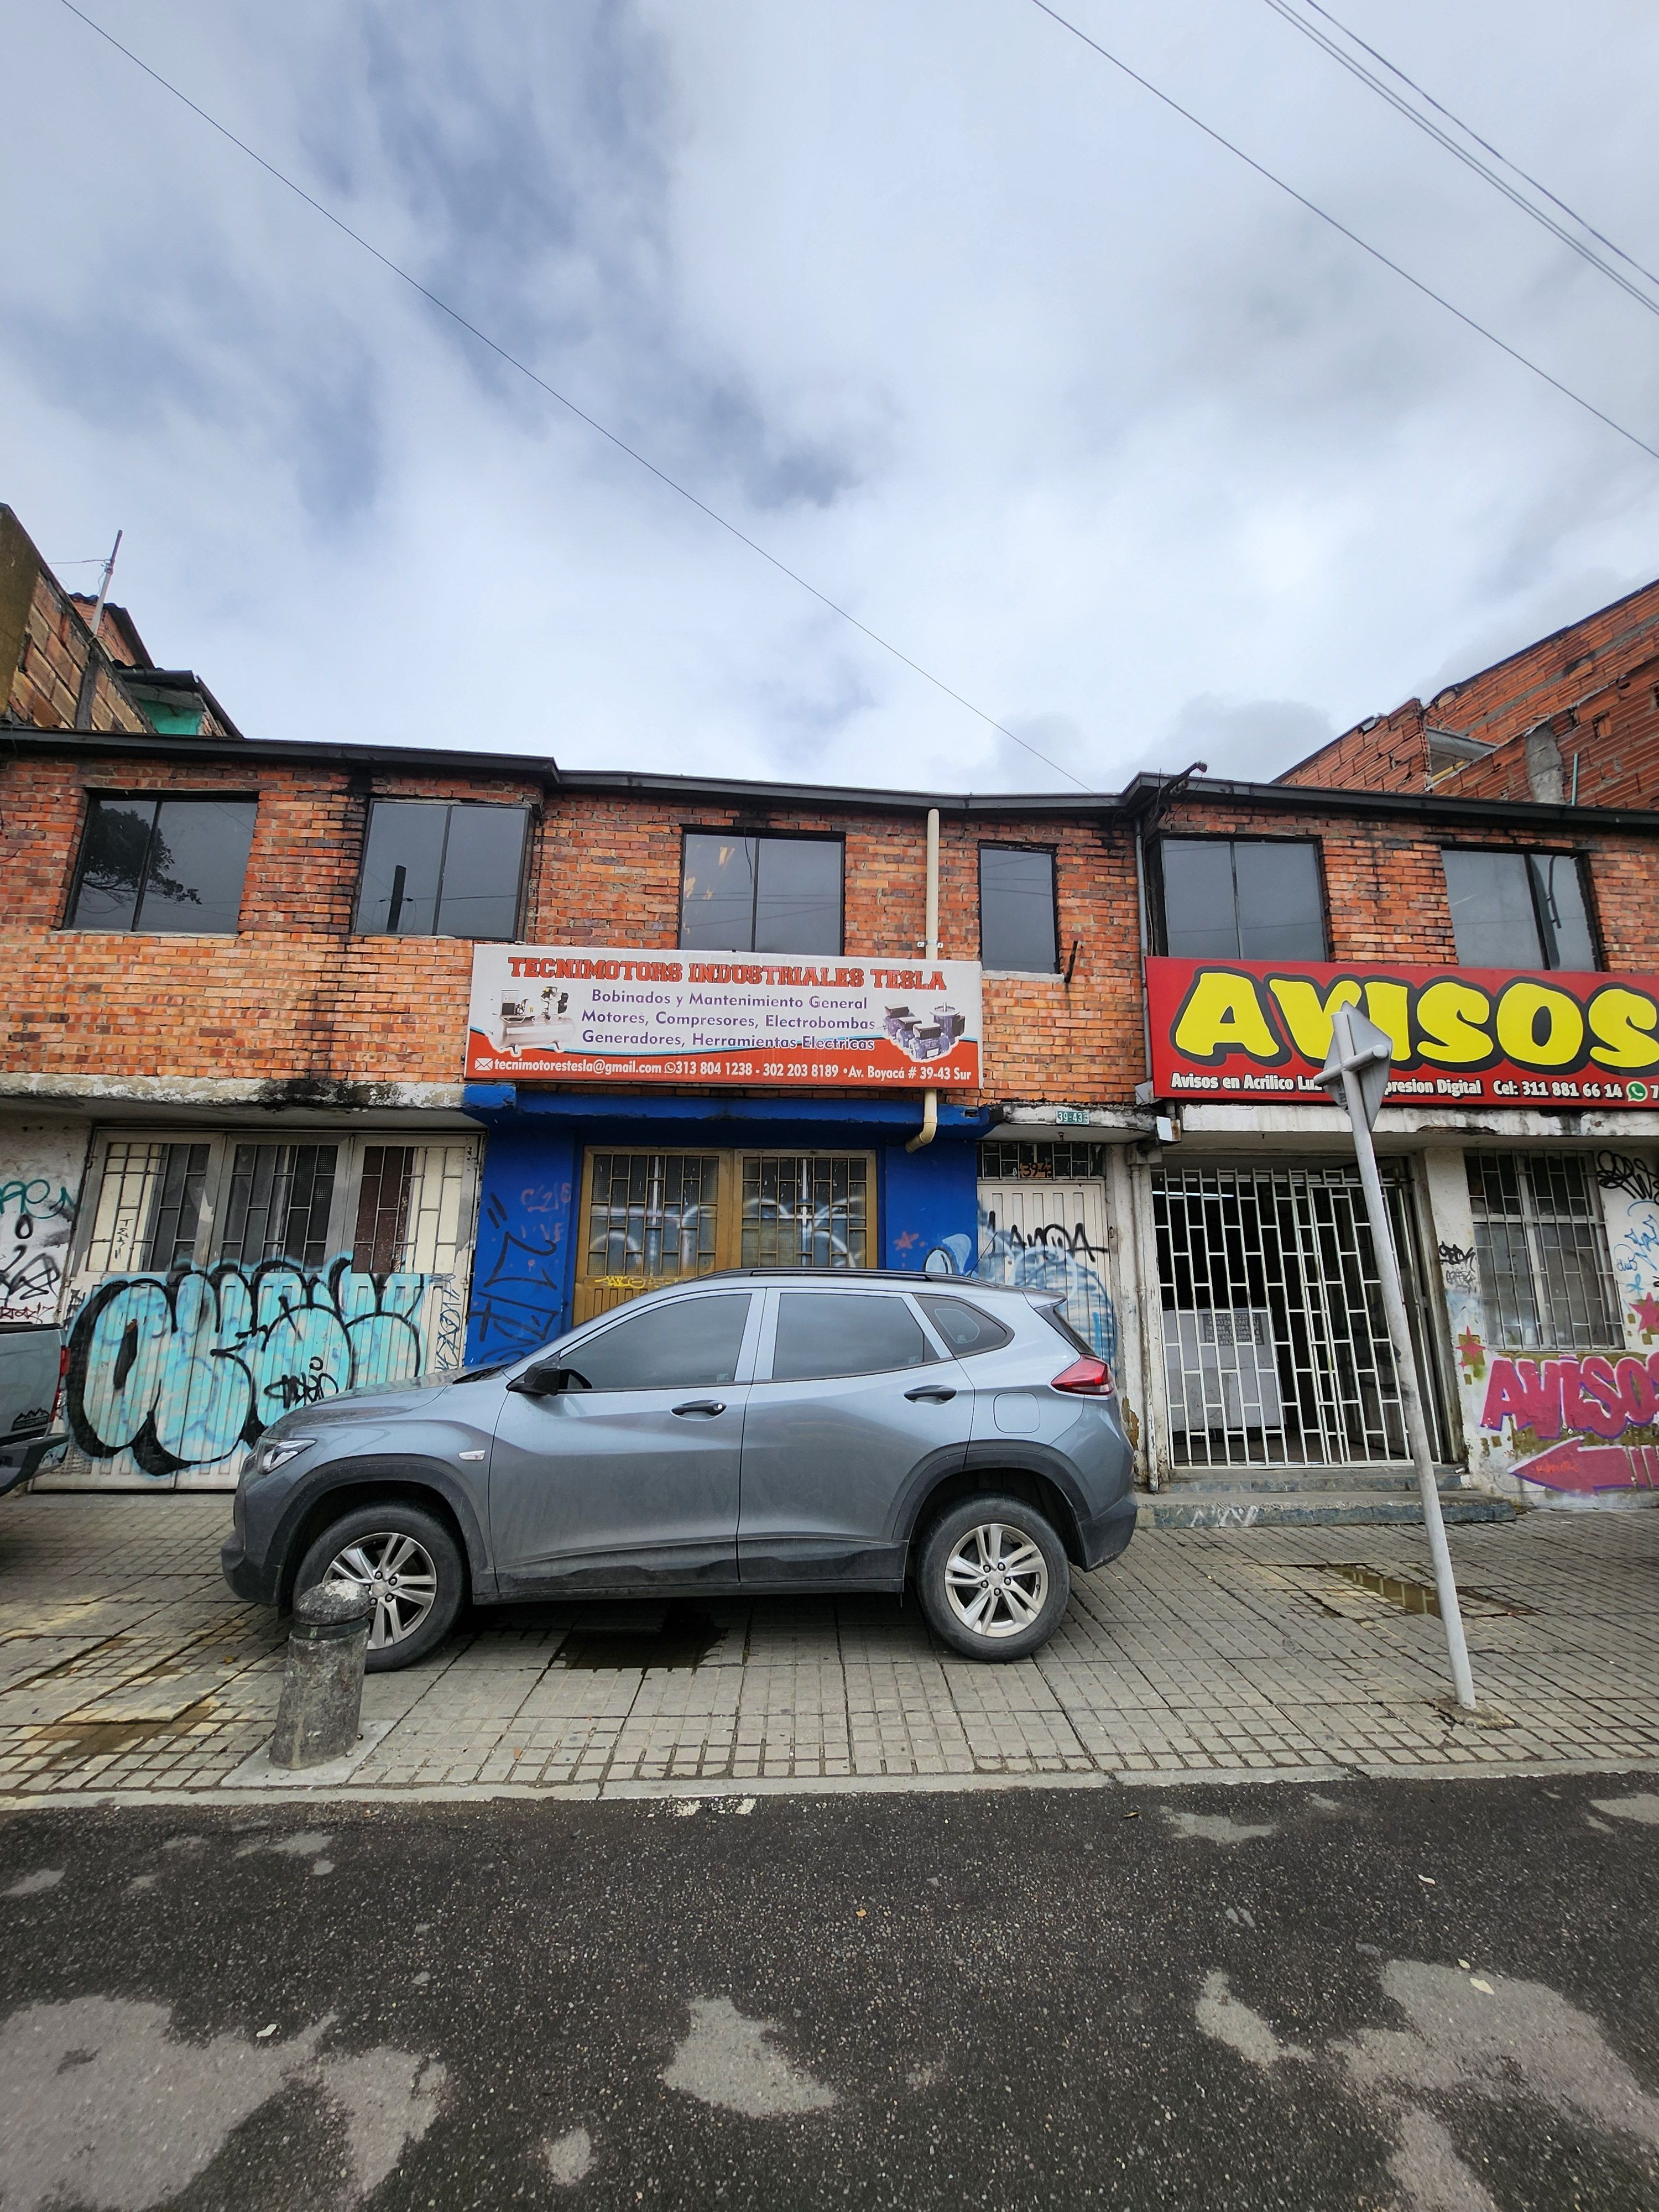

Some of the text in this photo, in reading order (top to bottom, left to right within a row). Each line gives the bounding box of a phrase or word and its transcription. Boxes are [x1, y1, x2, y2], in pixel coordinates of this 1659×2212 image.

[508, 957, 947, 990] TECNIMOTORS INDUSTRIALES TESLA
[592, 989, 867, 1009] Bobinados y Mantenimiento General
[582, 1009, 875, 1030] Motores, Compresores, Electrobombas
[1175, 972, 1659, 1068] AVISOS
[582, 1030, 875, 1051] Generadores, Herramientas Electricas
[494, 1058, 662, 1076] tecnimotorestesla@gmail.com
[675, 1061, 697, 1074] 313
[700, 1061, 721, 1074] 804
[726, 1062, 753, 1076] 1238
[763, 1063, 784, 1077] 302
[787, 1063, 808, 1077] 203
[811, 1064, 838, 1078] 8189
[867, 1066, 905, 1081] Boyacá
[908, 1067, 916, 1079] #
[920, 1066, 951, 1080] 39-43
[953, 1067, 972, 1081] Sur
[1171, 1073, 1218, 1088] Avisos
[1223, 1077, 1240, 1089] en
[1244, 1074, 1293, 1090] Acrilico
[1384, 1078, 1433, 1096] presion
[1438, 1079, 1481, 1097] Digital
[1493, 1080, 1519, 1095] Cel:
[1522, 1081, 1549, 1096] 311
[1552, 1082, 1579, 1097] 881
[1583, 1083, 1600, 1097] 66
[1604, 1084, 1623, 1098] 14
[1058, 1112, 1083, 1123] 39-43
